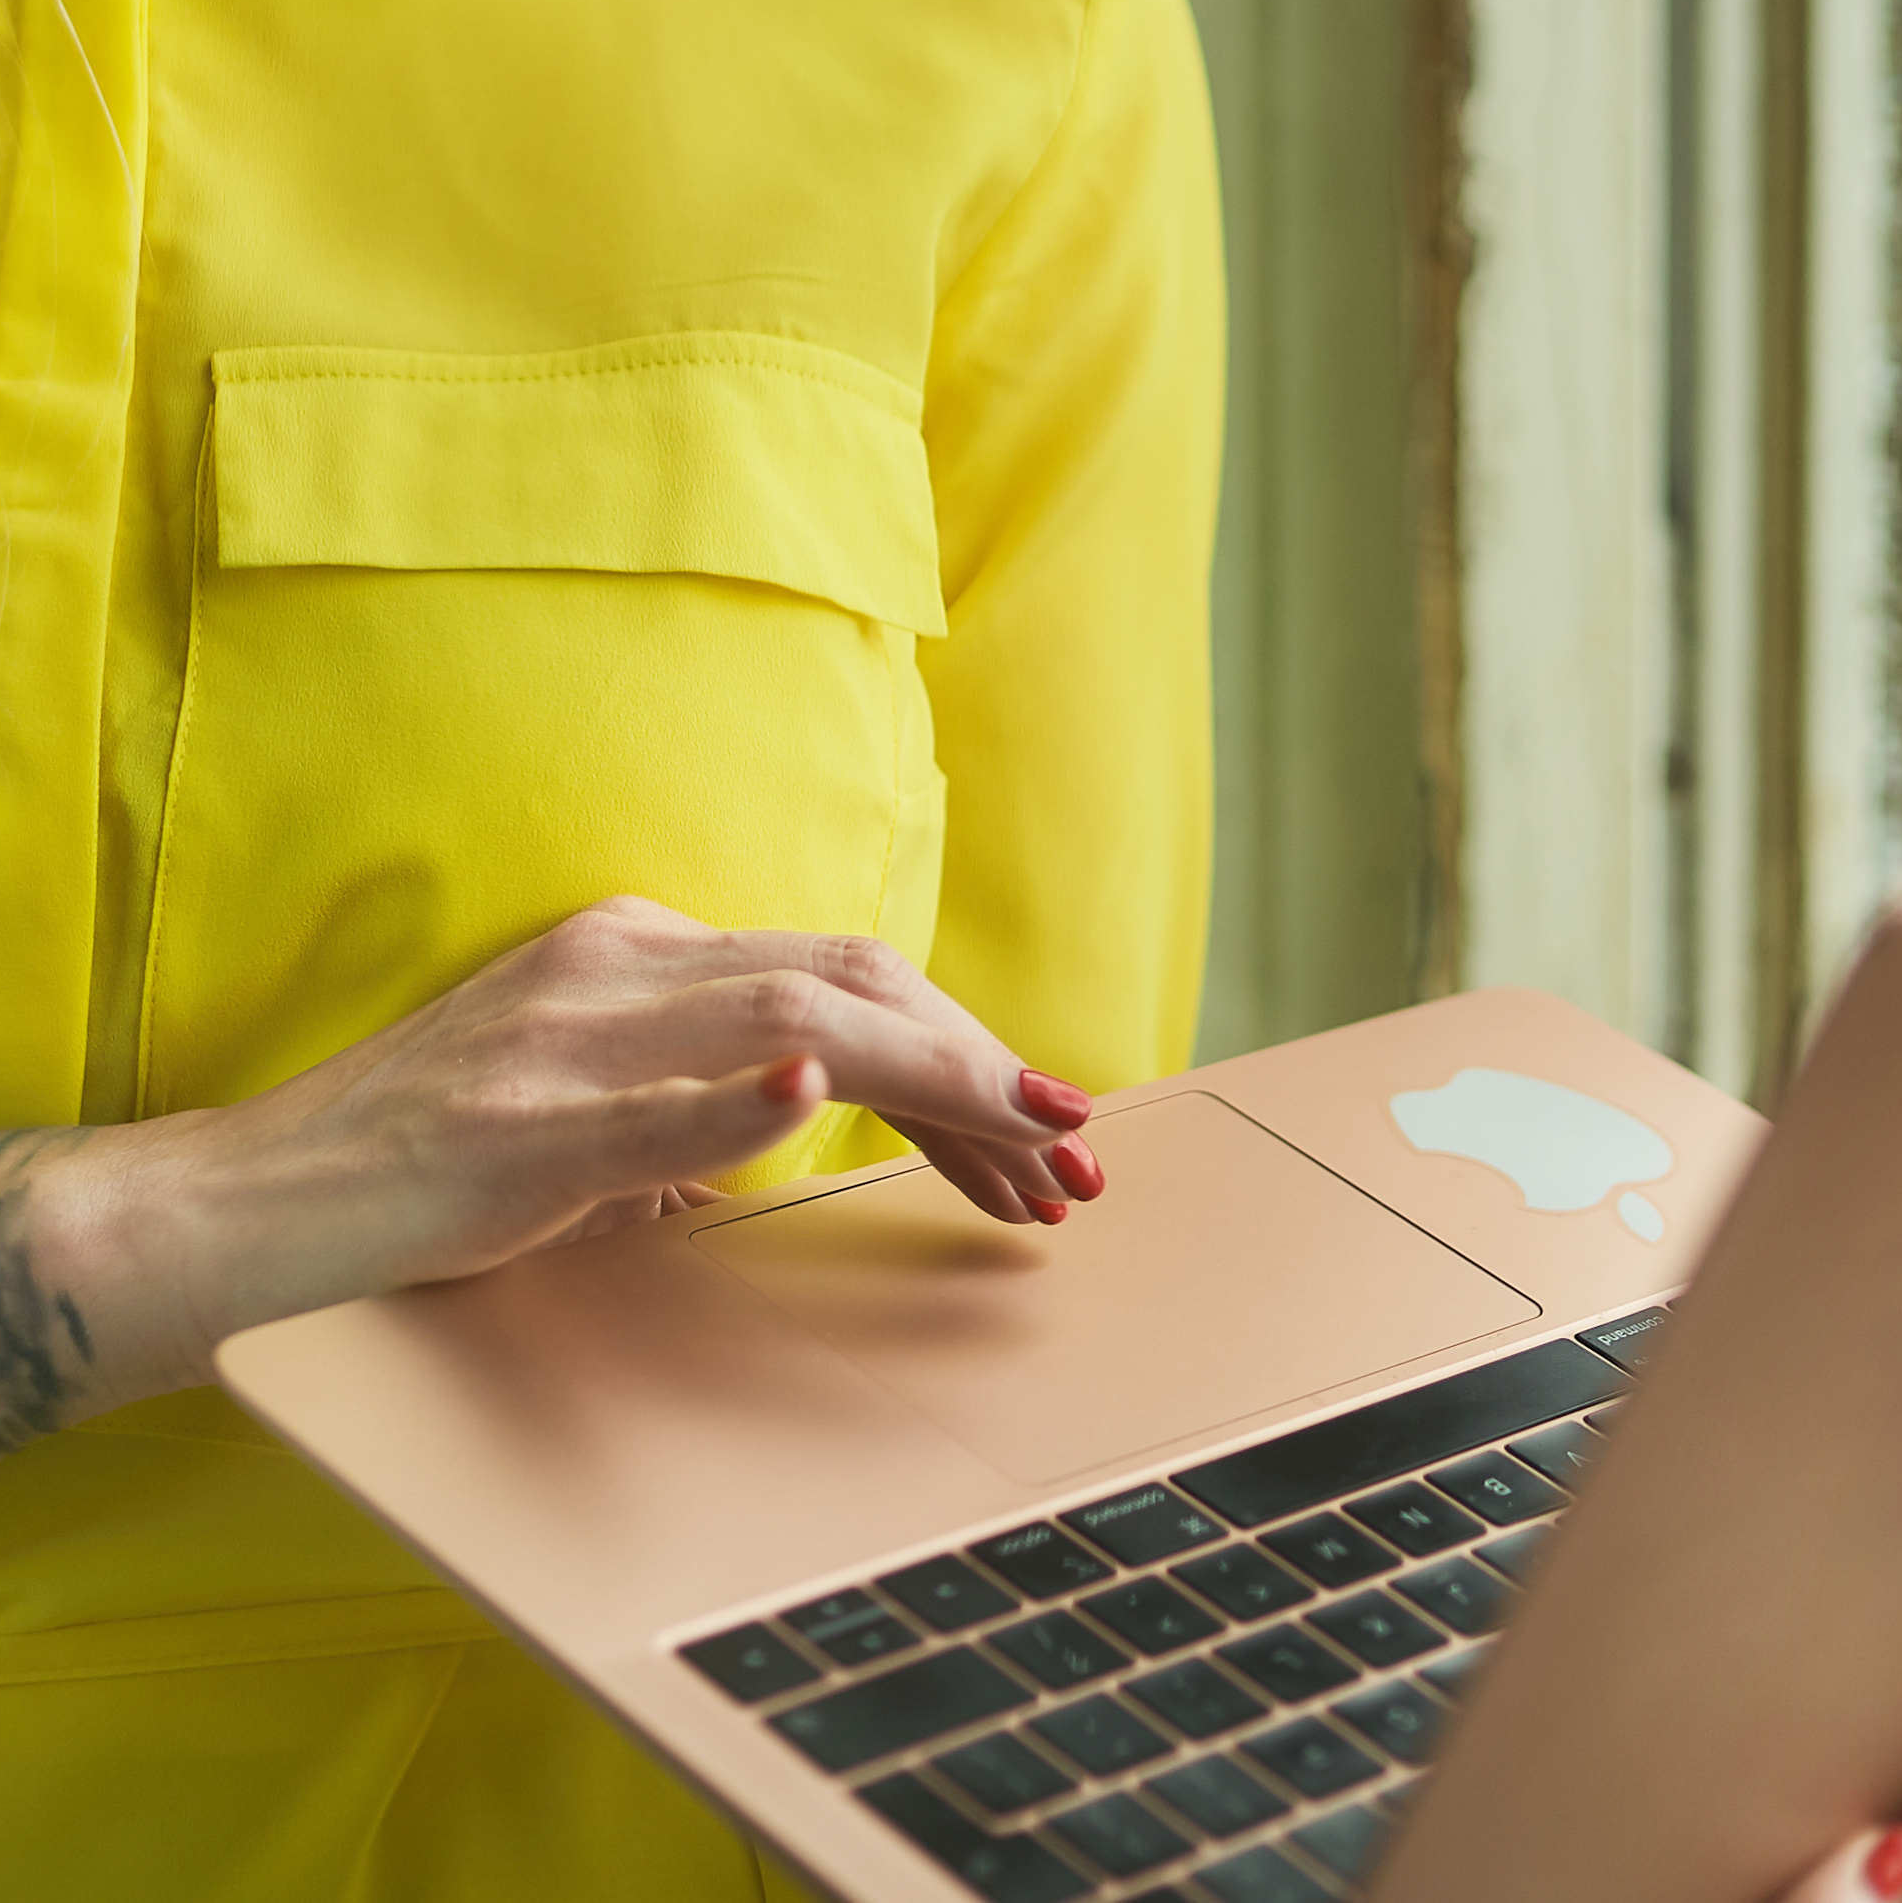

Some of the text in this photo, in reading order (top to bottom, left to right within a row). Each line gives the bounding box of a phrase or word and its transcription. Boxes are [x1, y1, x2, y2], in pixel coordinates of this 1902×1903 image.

[1597, 1314, 1665, 1347] command
[1483, 1476, 1512, 1497] B
[1083, 1487, 1166, 1528] command
[1399, 1505, 1431, 1529] N
